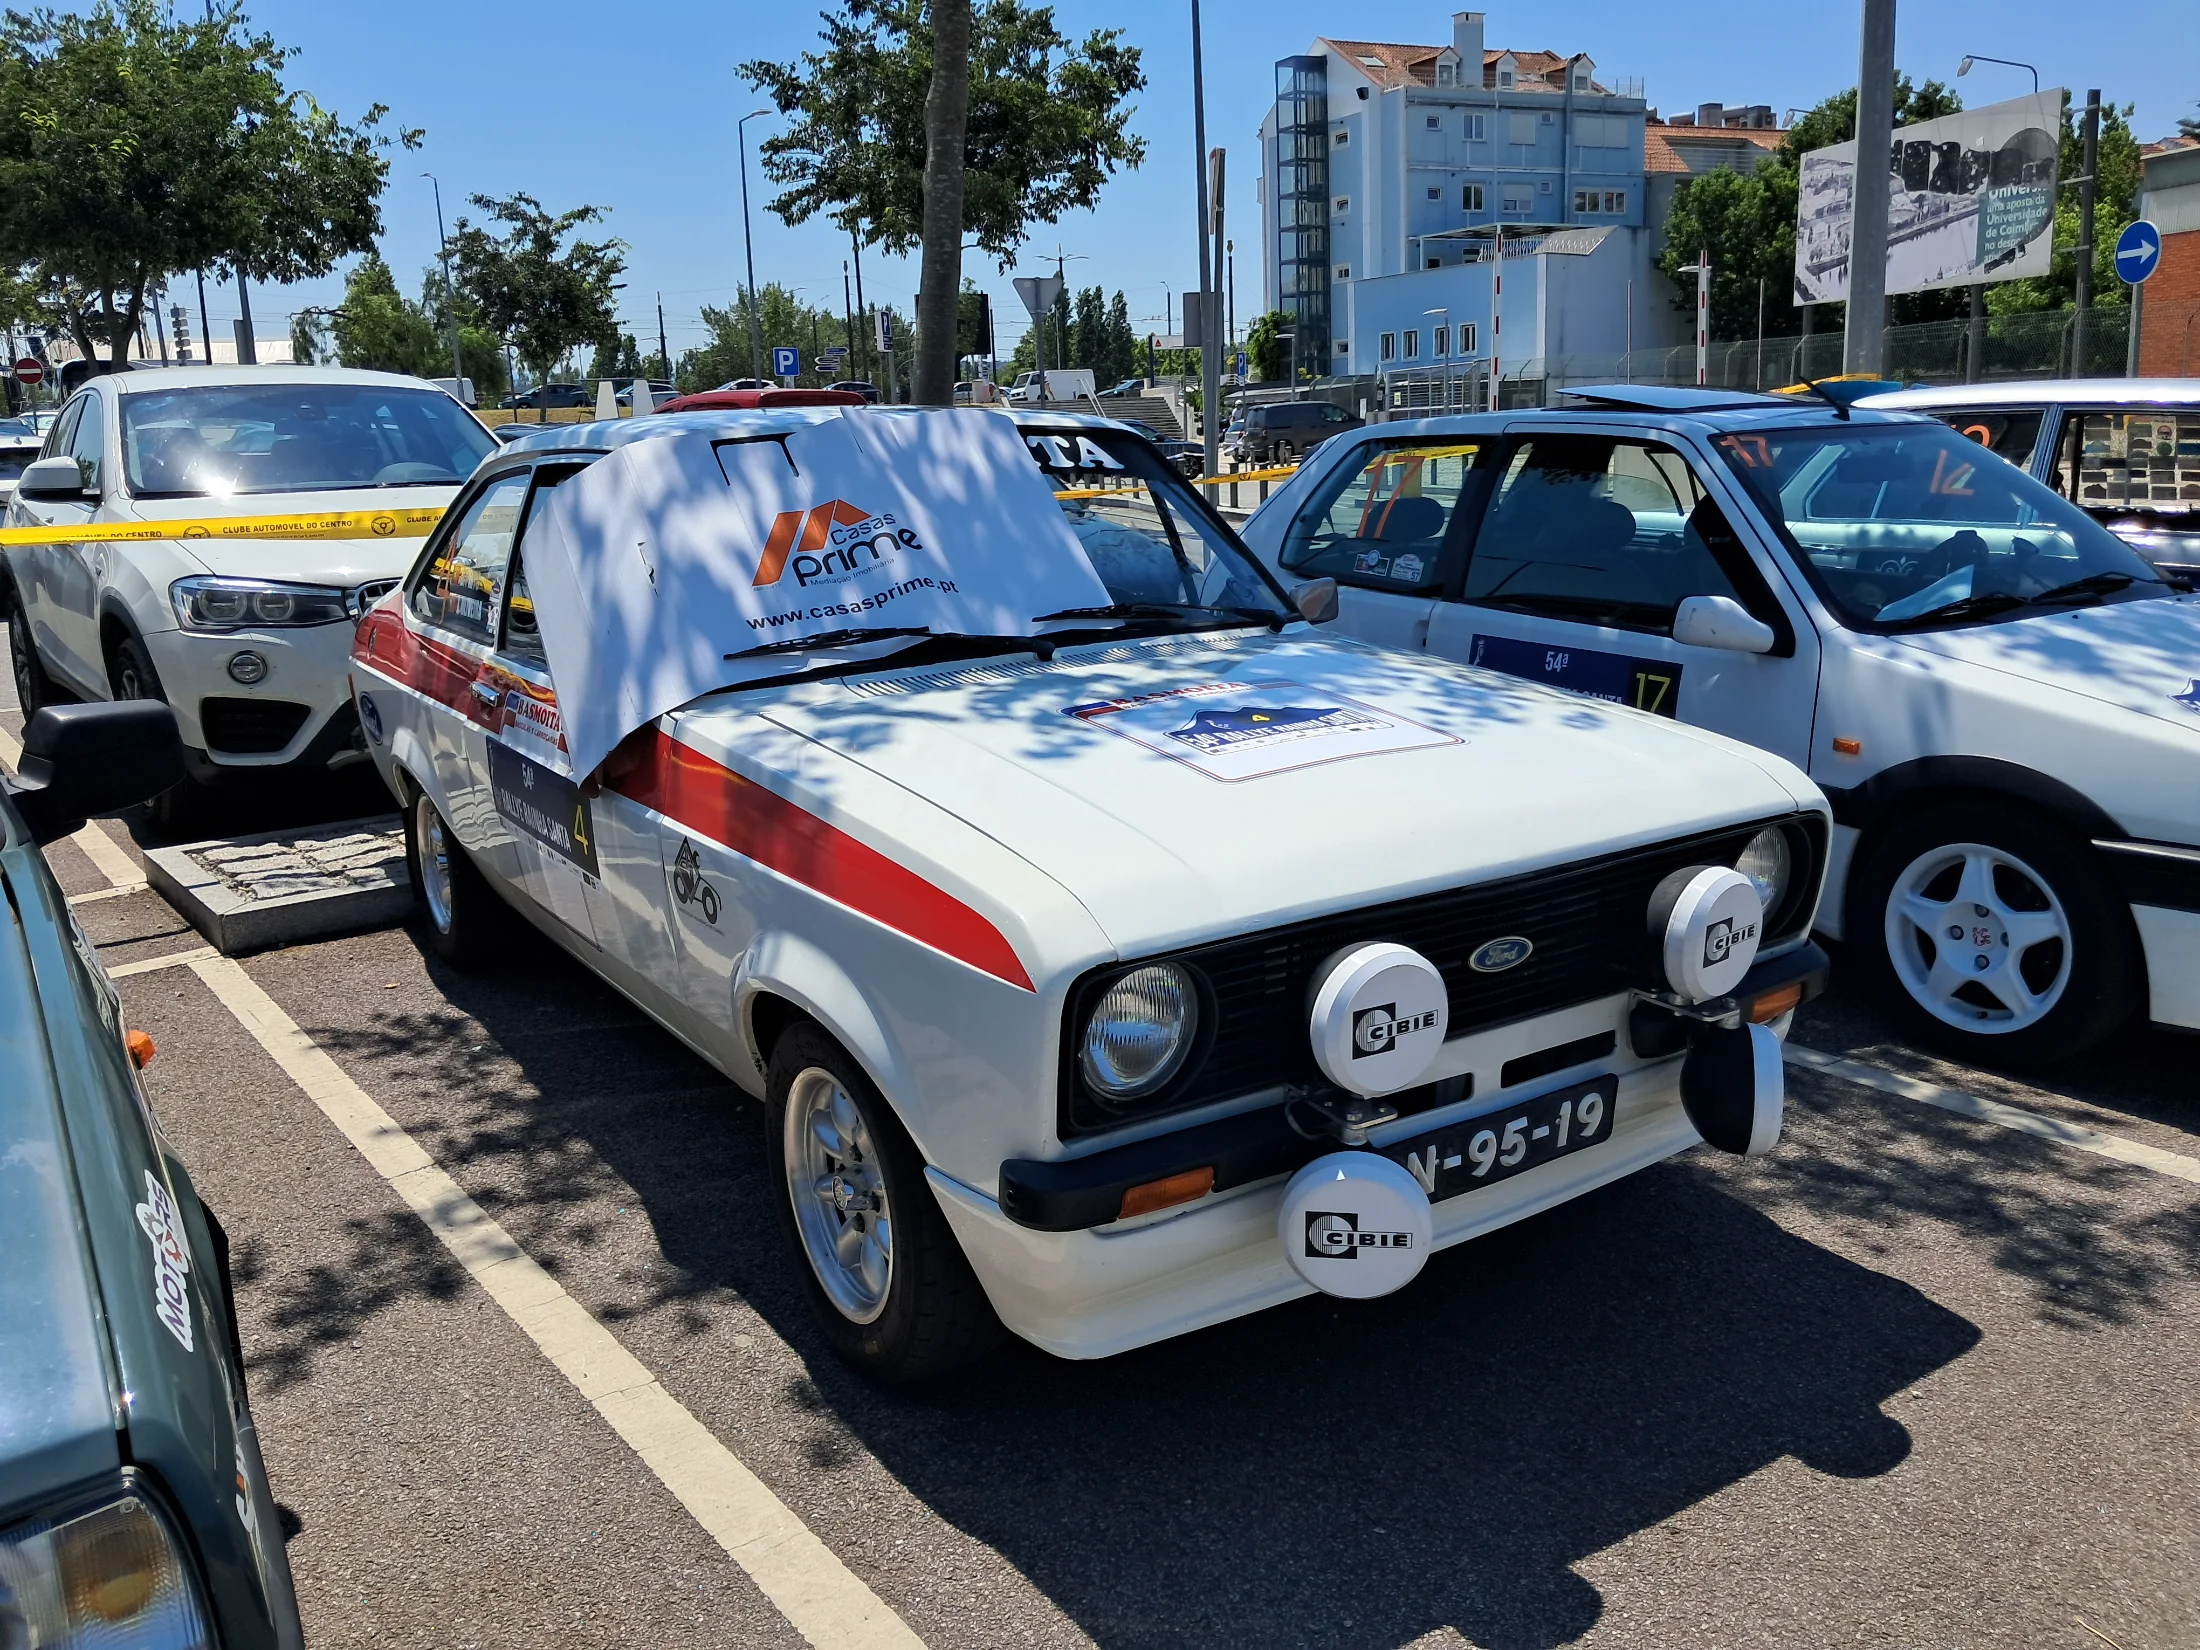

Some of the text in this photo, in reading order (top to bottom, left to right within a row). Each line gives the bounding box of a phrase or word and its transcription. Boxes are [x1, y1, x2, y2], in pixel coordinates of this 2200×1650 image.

[1986, 206, 2048, 225] Universidade
[1987, 194, 2046, 213] uma aposta da
[1985, 227, 1997, 238] de
[1984, 242, 1995, 251] no
[779, 351, 794, 373] P
[1720, 435, 1774, 468] 17
[1356, 452, 1425, 538] 17
[222, 525, 251, 534] CLUBE
[319, 520, 353, 528] CENTRO
[406, 515, 432, 524] CLUBE
[830, 513, 897, 545] Casas
[791, 528, 923, 588] prime
[810, 556, 895, 587] Mediação Imobiliária
[745, 577, 959, 630] www.casasprime.pt
[1110, 682, 1249, 706] BASMOITA
[1635, 672, 1671, 714] 17
[517, 698, 560, 733] BASMOITA
[1217, 726, 1275, 745] RALLYE
[546, 816, 572, 853] SANTA
[574, 804, 589, 856] 4
[1714, 925, 1755, 951] CIBIE
[1485, 943, 1520, 966] Ford
[1369, 1012, 1435, 1040] CIBIE
[1326, 1231, 1408, 1247] CIBIE
